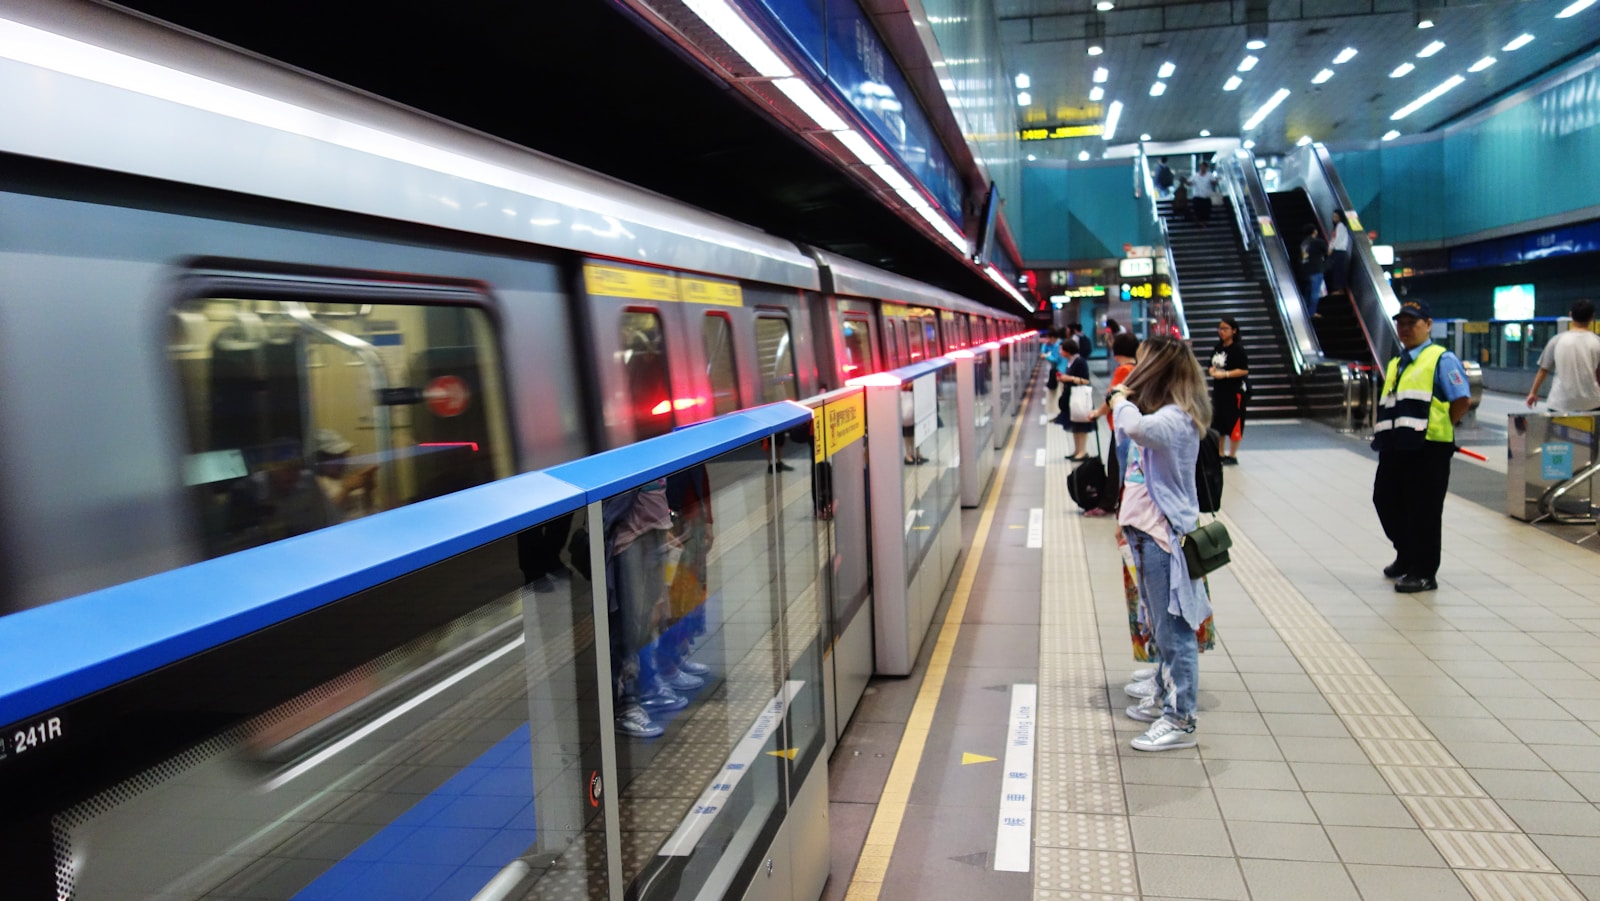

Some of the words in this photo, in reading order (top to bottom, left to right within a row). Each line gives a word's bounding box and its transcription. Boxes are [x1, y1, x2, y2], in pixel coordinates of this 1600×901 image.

[1016, 705, 1031, 719] Line
[14, 716, 62, 754] 241R
[1013, 721, 1033, 746] Waiting
